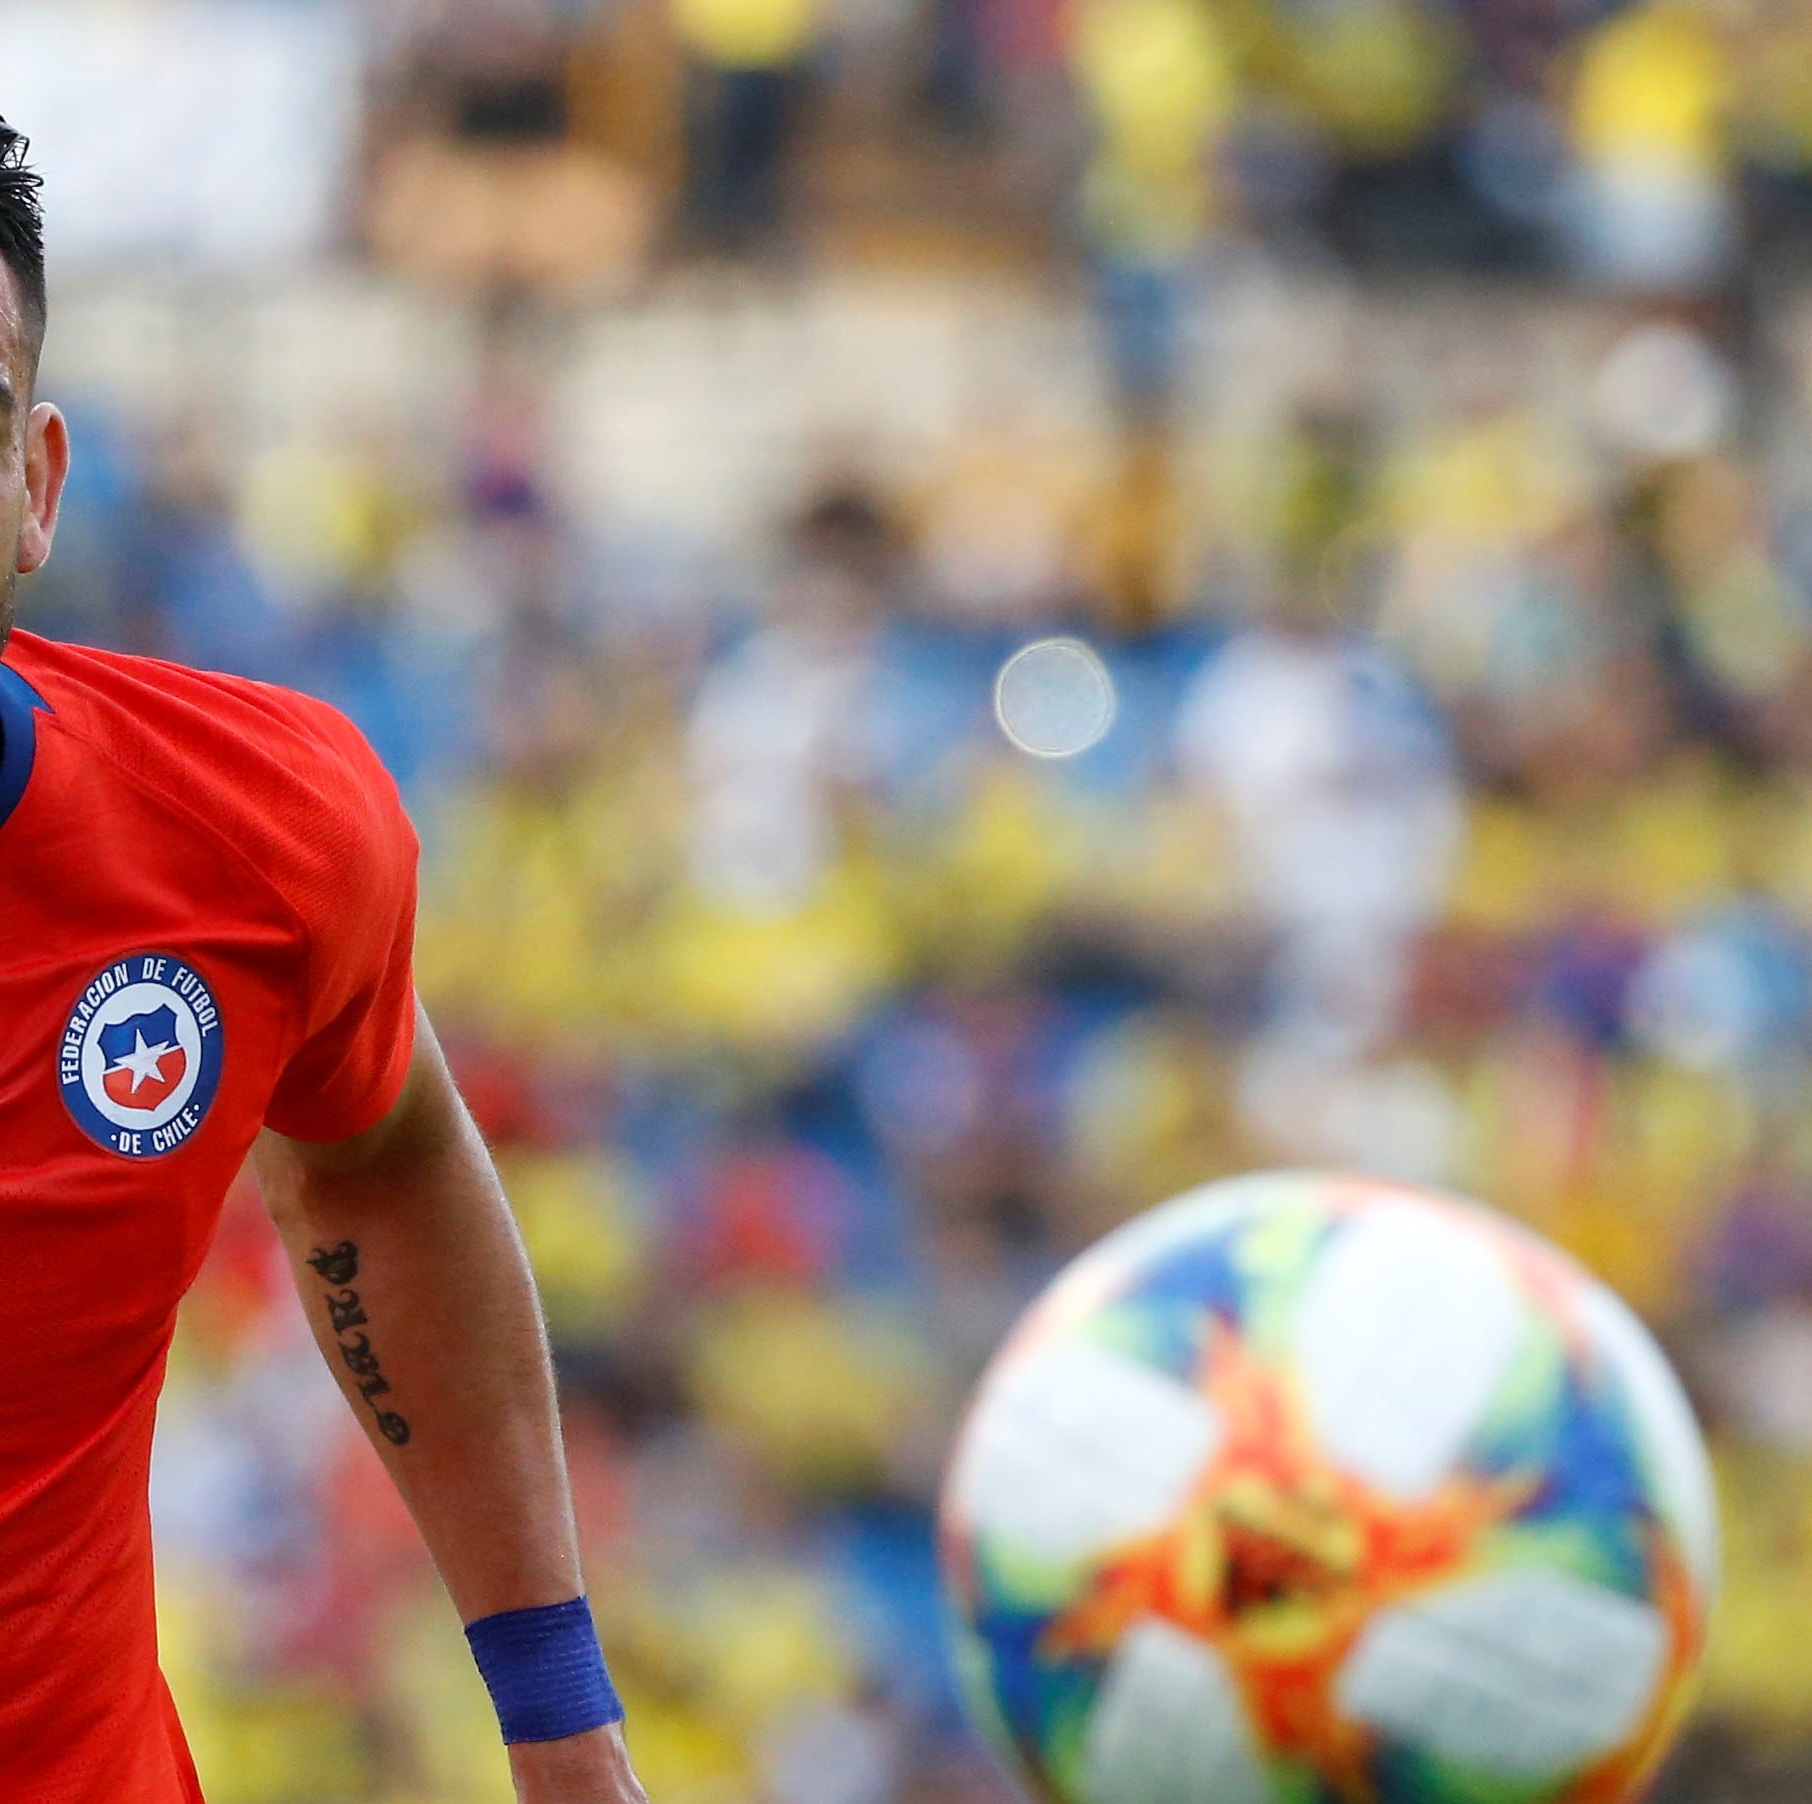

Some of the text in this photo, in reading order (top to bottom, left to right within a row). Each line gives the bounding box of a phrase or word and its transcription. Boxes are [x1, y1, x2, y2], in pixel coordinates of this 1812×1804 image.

[61, 957, 220, 1085] FEDERACION DE FUTBOL
[118, 1107, 199, 1154] DE CHILE
